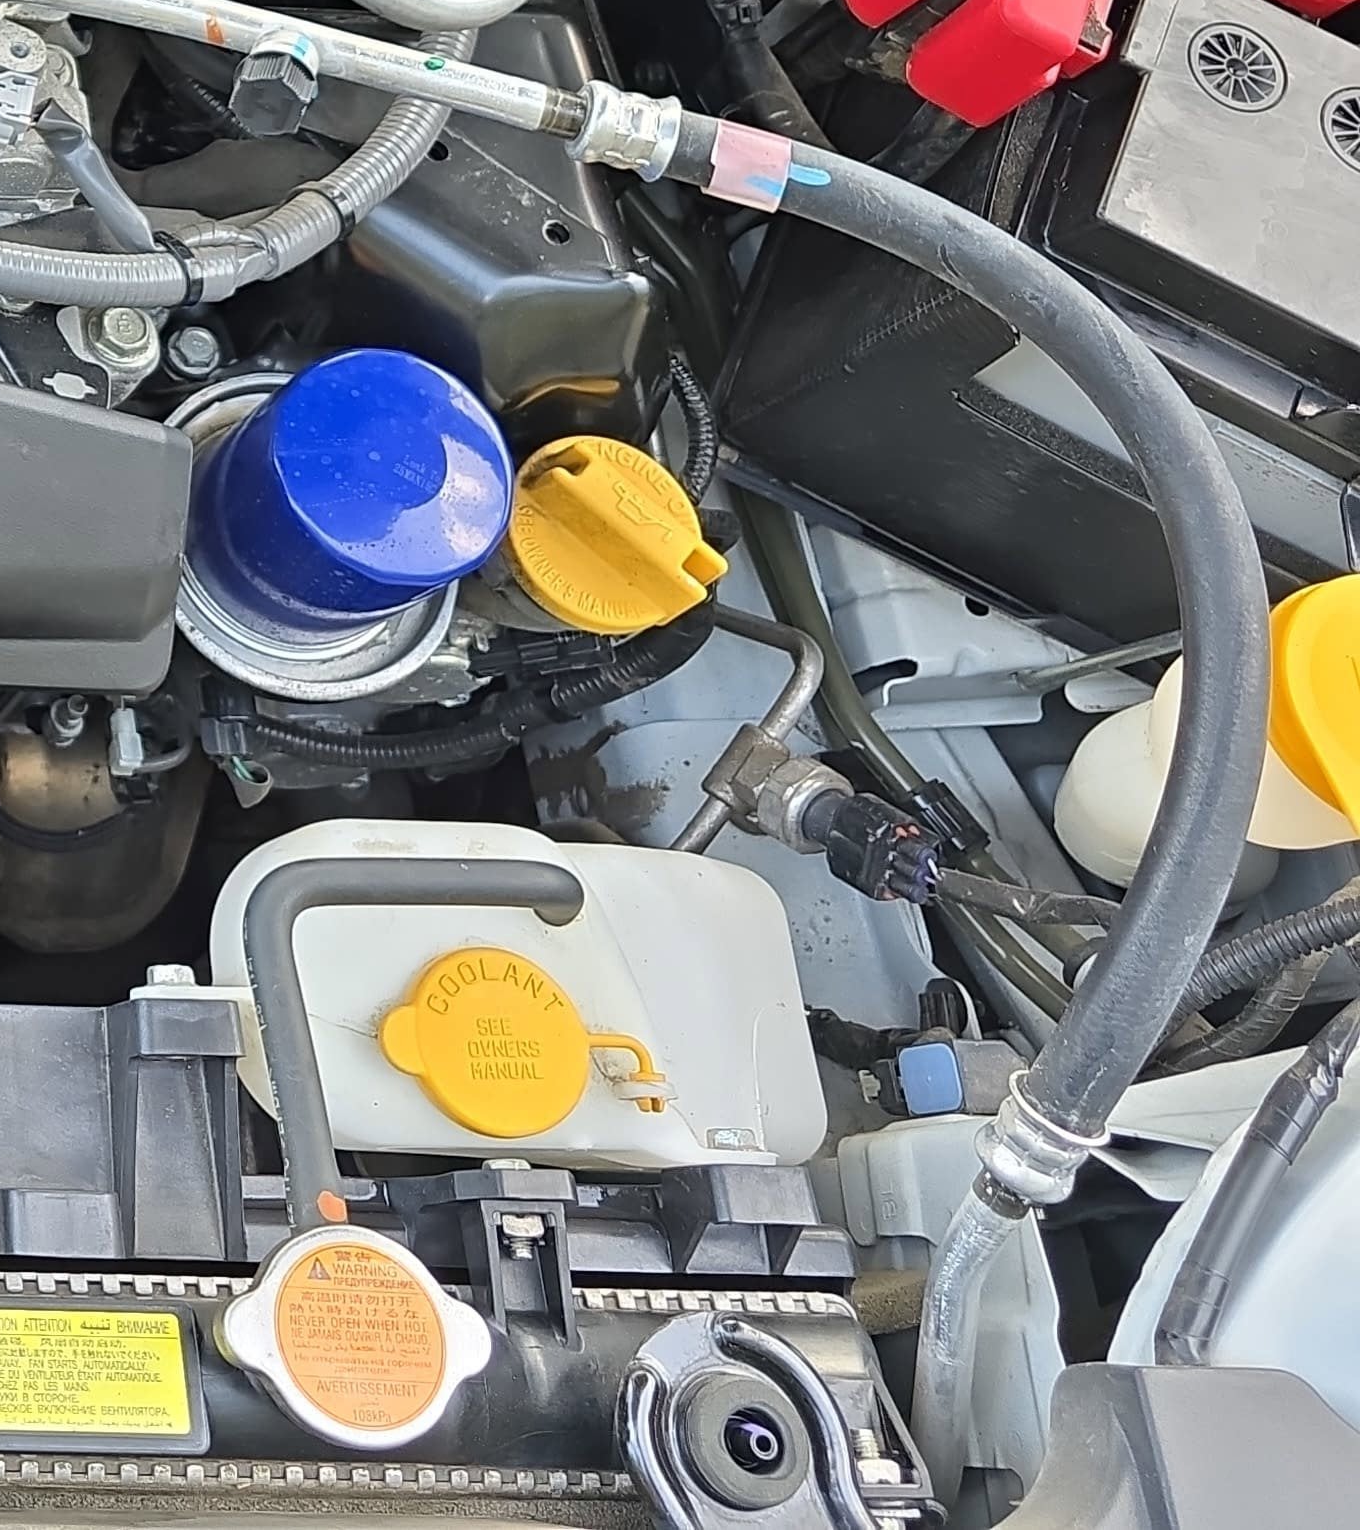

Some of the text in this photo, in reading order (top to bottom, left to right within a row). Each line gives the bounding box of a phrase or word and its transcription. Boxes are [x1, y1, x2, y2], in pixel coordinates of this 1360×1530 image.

[426, 957, 564, 1016] COOLANT
[476, 1017, 513, 1037] SEE
[470, 1061, 545, 1081] MANUAL
[332, 1263, 398, 1277] WARNING
[23, 1318, 72, 1332] ATTENTION
[289, 1315, 326, 1327] NEVER
[331, 1316, 361, 1330] OPEN
[366, 1319, 399, 1332] WHEN
[316, 1380, 419, 1398] AVERTISSEMENT
